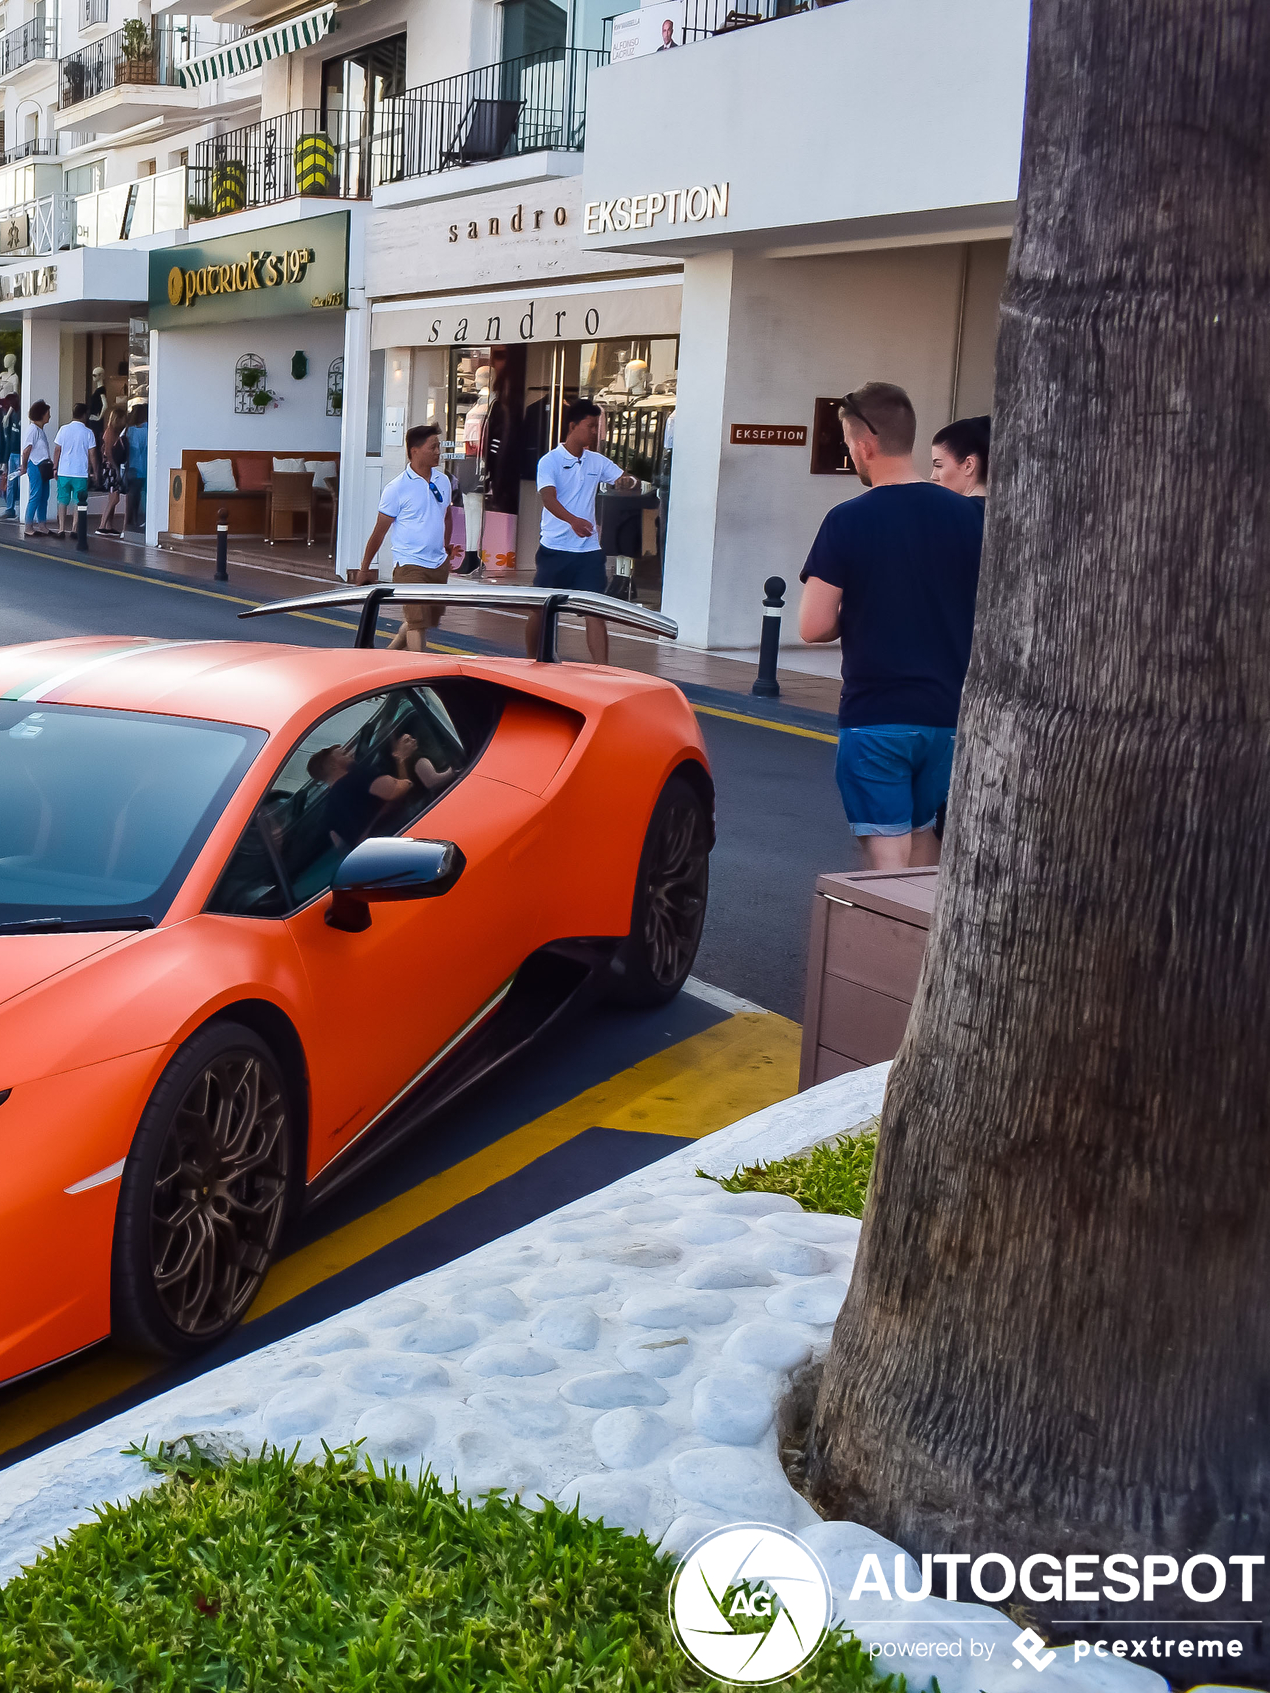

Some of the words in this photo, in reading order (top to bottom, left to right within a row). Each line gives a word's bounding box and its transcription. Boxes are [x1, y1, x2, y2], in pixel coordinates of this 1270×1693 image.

[448, 204, 568, 243] sandro
[583, 182, 730, 235] EKSEPTION
[427, 300, 601, 344] sandro
[736, 429, 804, 440] EKSEPTION
